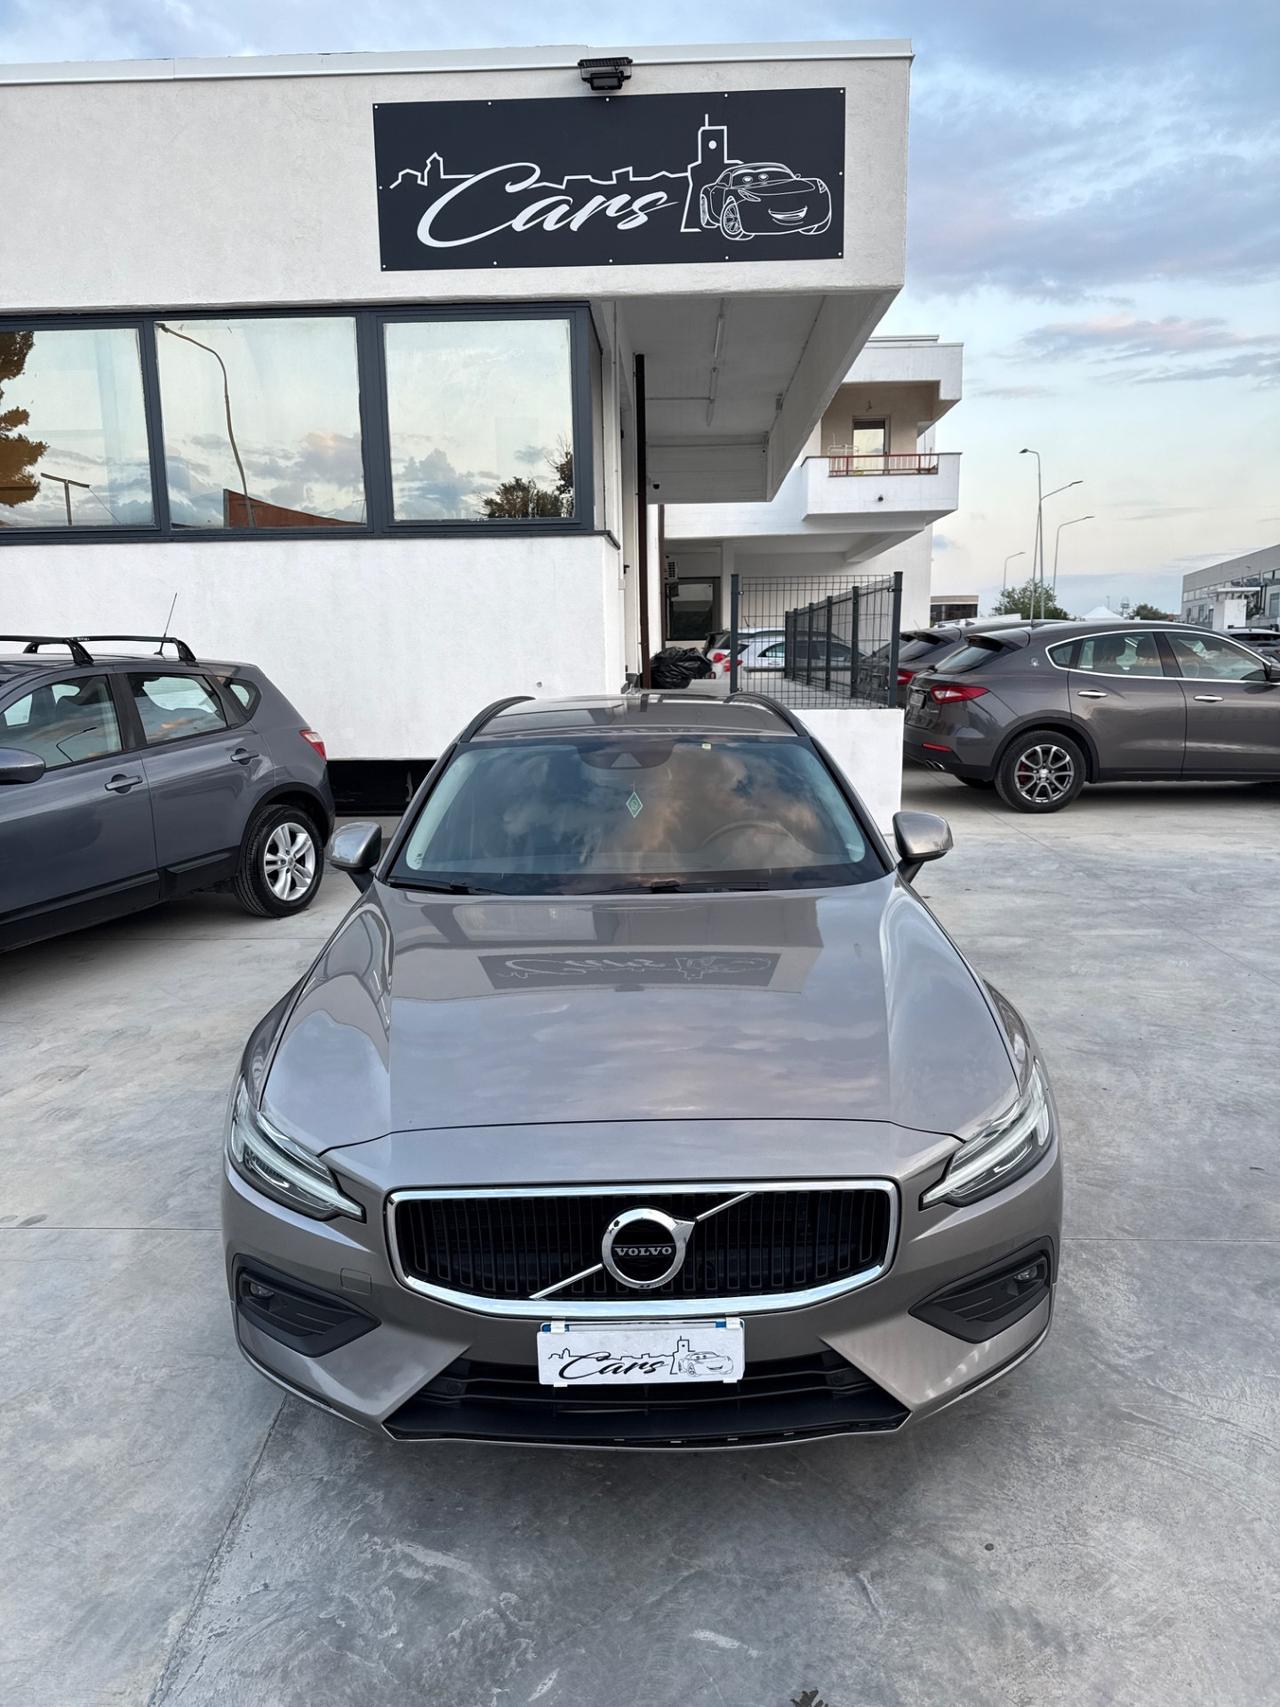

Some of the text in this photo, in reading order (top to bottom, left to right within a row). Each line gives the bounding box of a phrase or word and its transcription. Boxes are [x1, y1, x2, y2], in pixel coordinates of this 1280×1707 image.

[416, 162, 679, 248] Cars
[614, 1246, 672, 1257] VOLVO
[558, 1351, 670, 1380] Cars
